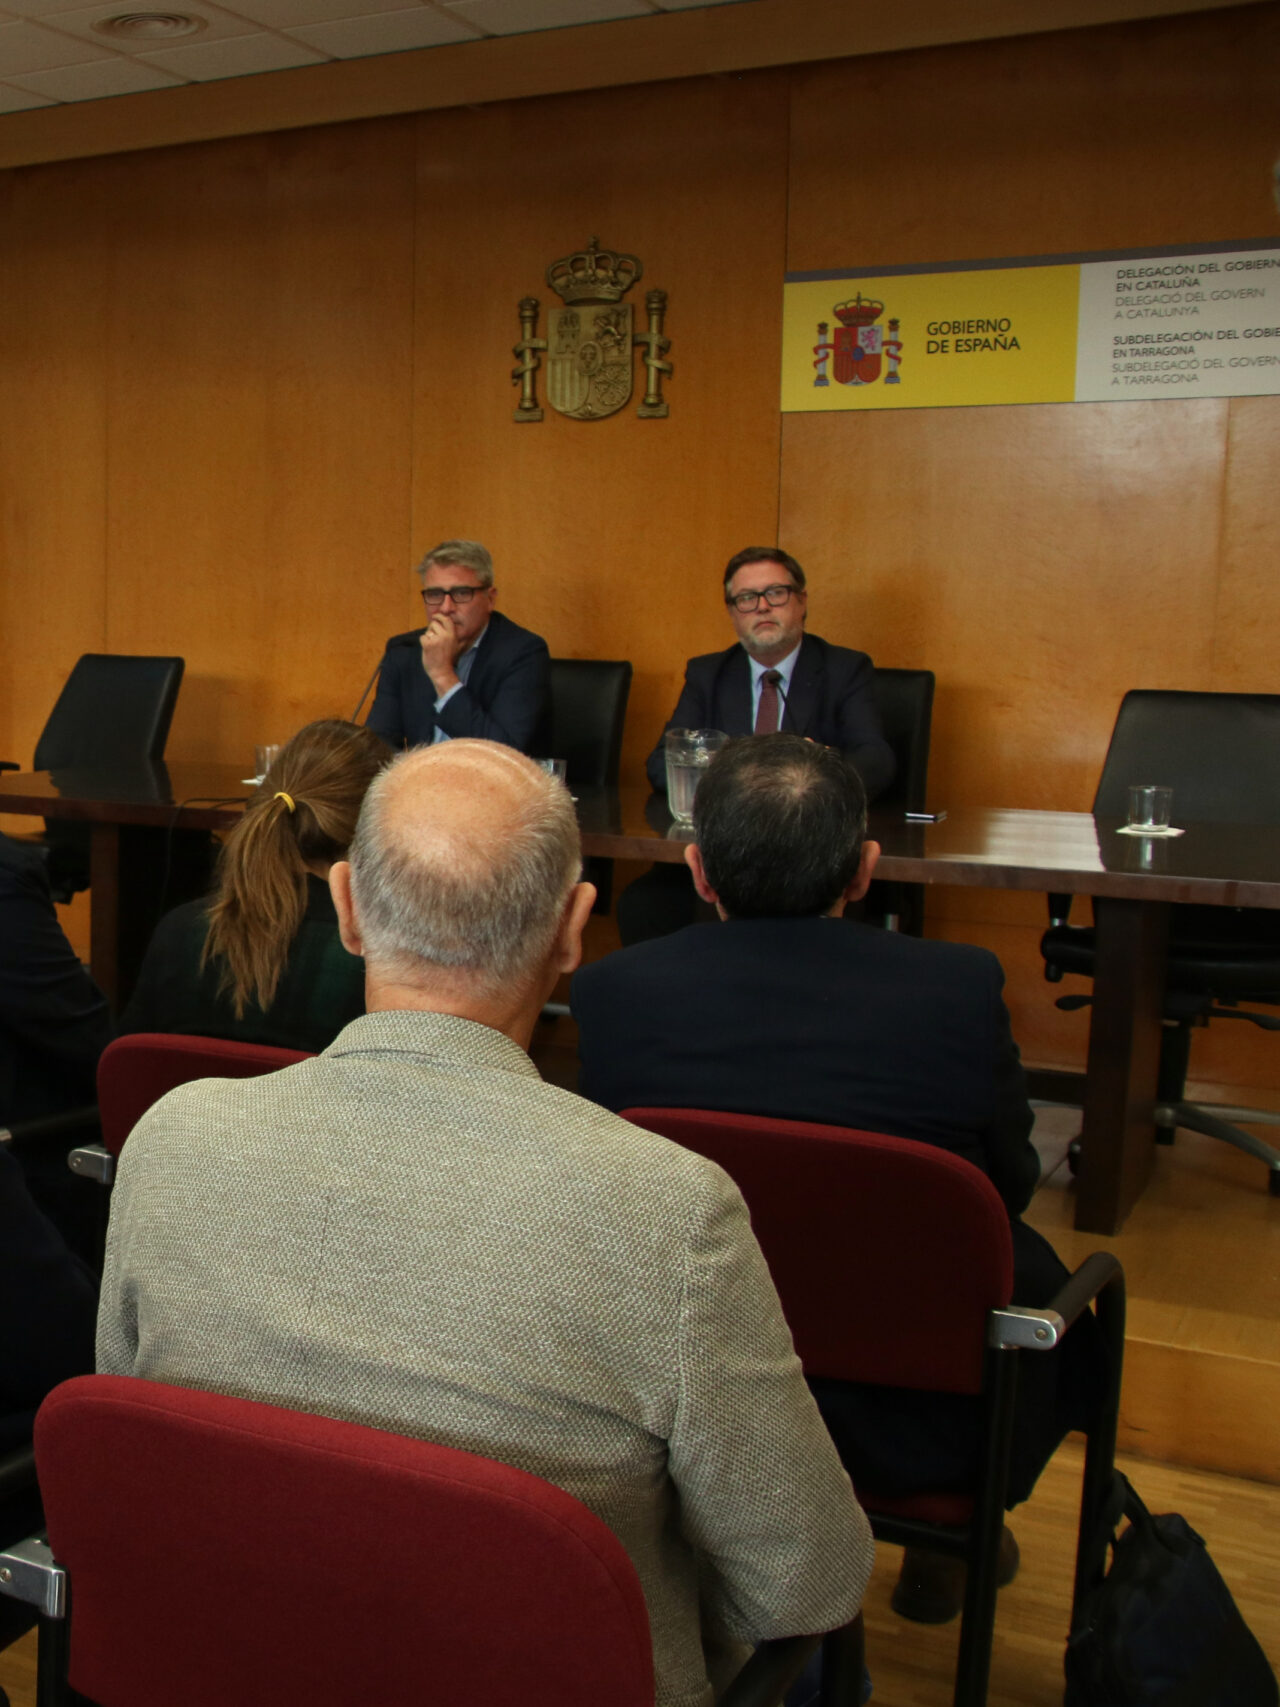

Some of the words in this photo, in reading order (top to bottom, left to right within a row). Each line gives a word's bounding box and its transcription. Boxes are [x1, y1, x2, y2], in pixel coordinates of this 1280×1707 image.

[1117, 263, 1195, 279] DELEGACIÓN
[1198, 263, 1221, 274] DEL
[1116, 282, 1132, 292] EN
[1135, 276, 1200, 291] CATALUÑA
[1115, 291, 1181, 307] DELEGACIÓ
[1185, 292, 1207, 303] DEL
[1210, 288, 1265, 301] GOVERN
[1114, 310, 1123, 320] A
[1126, 306, 1200, 319] CATALUNYA
[927, 318, 1011, 336] GOBIERNO
[927, 339, 950, 354] DE
[955, 334, 1021, 353] ESPAÑA
[1113, 329, 1214, 345] SUBDELEGACIÓN
[1216, 329, 1239, 340] DEL
[1113, 349, 1127, 358] EN
[1129, 345, 1195, 357] TARRAGONA
[1112, 357, 1200, 373] SUBDELEGACIÓ
[1203, 359, 1225, 369] DEL
[1111, 377, 1120, 385] A
[1123, 373, 1199, 385] TARRAGONA
